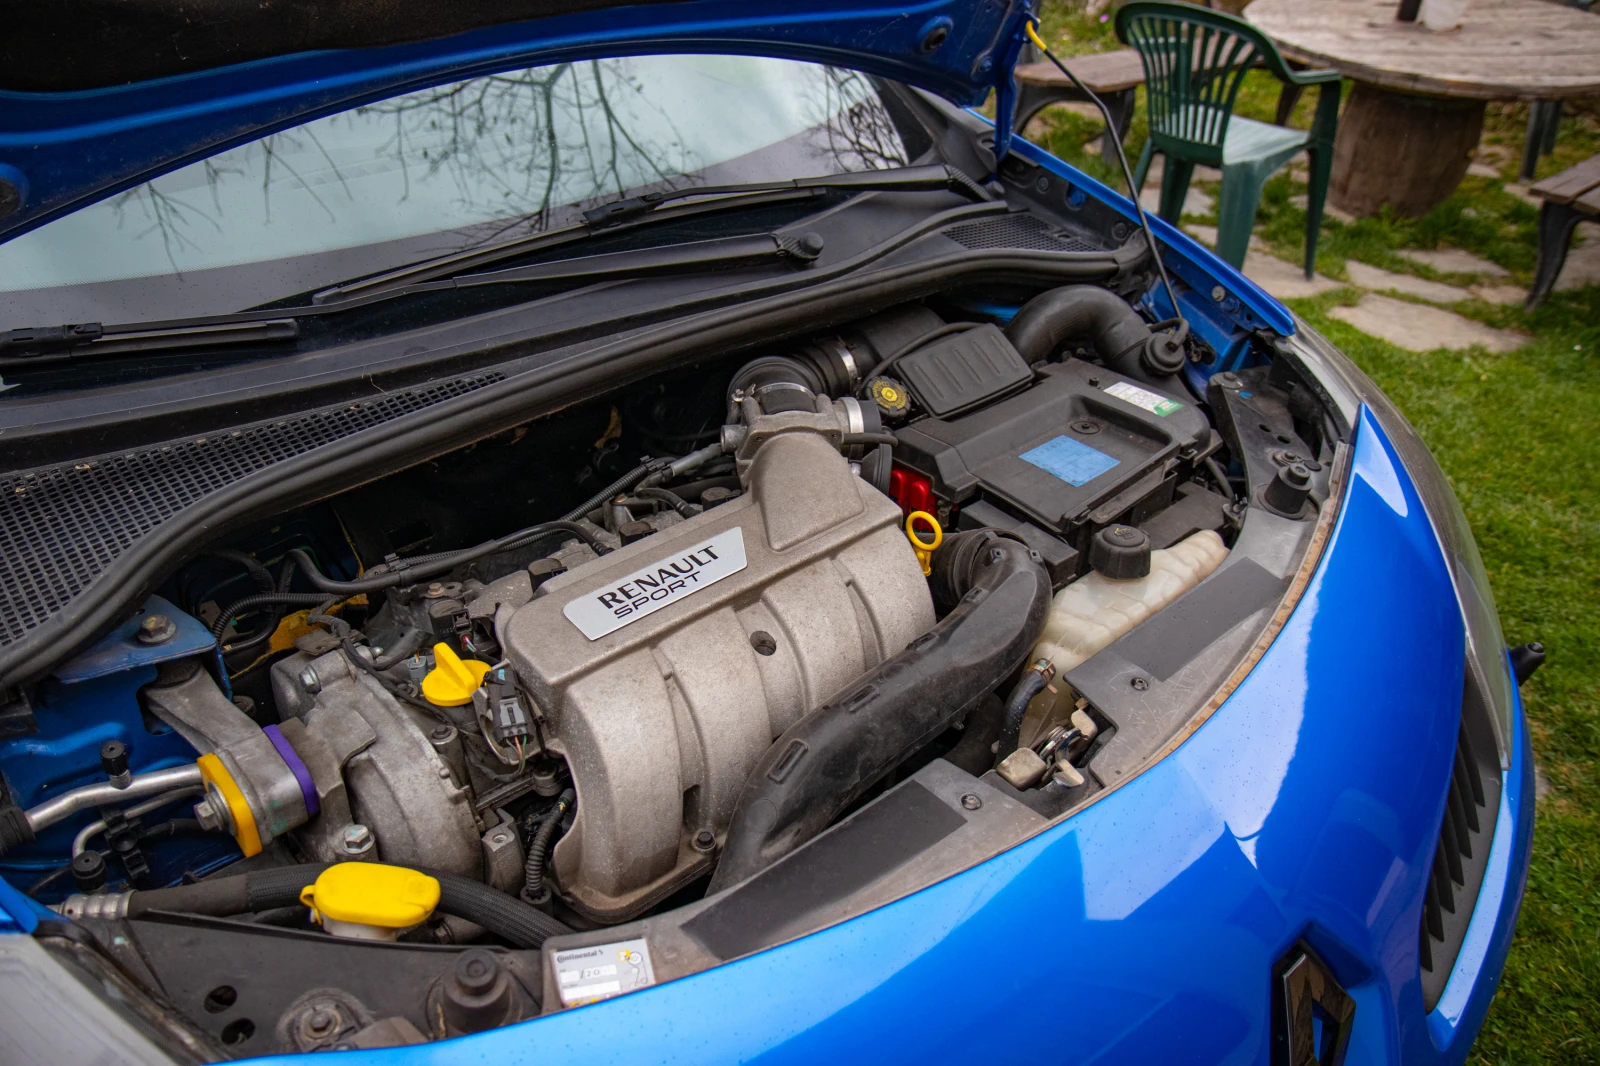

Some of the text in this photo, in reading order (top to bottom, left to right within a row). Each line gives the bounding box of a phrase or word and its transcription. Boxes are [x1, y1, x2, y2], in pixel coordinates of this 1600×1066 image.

[597, 545, 719, 609] RENAULT
[613, 571, 701, 619] SPORT
[556, 950, 598, 963] Continental
